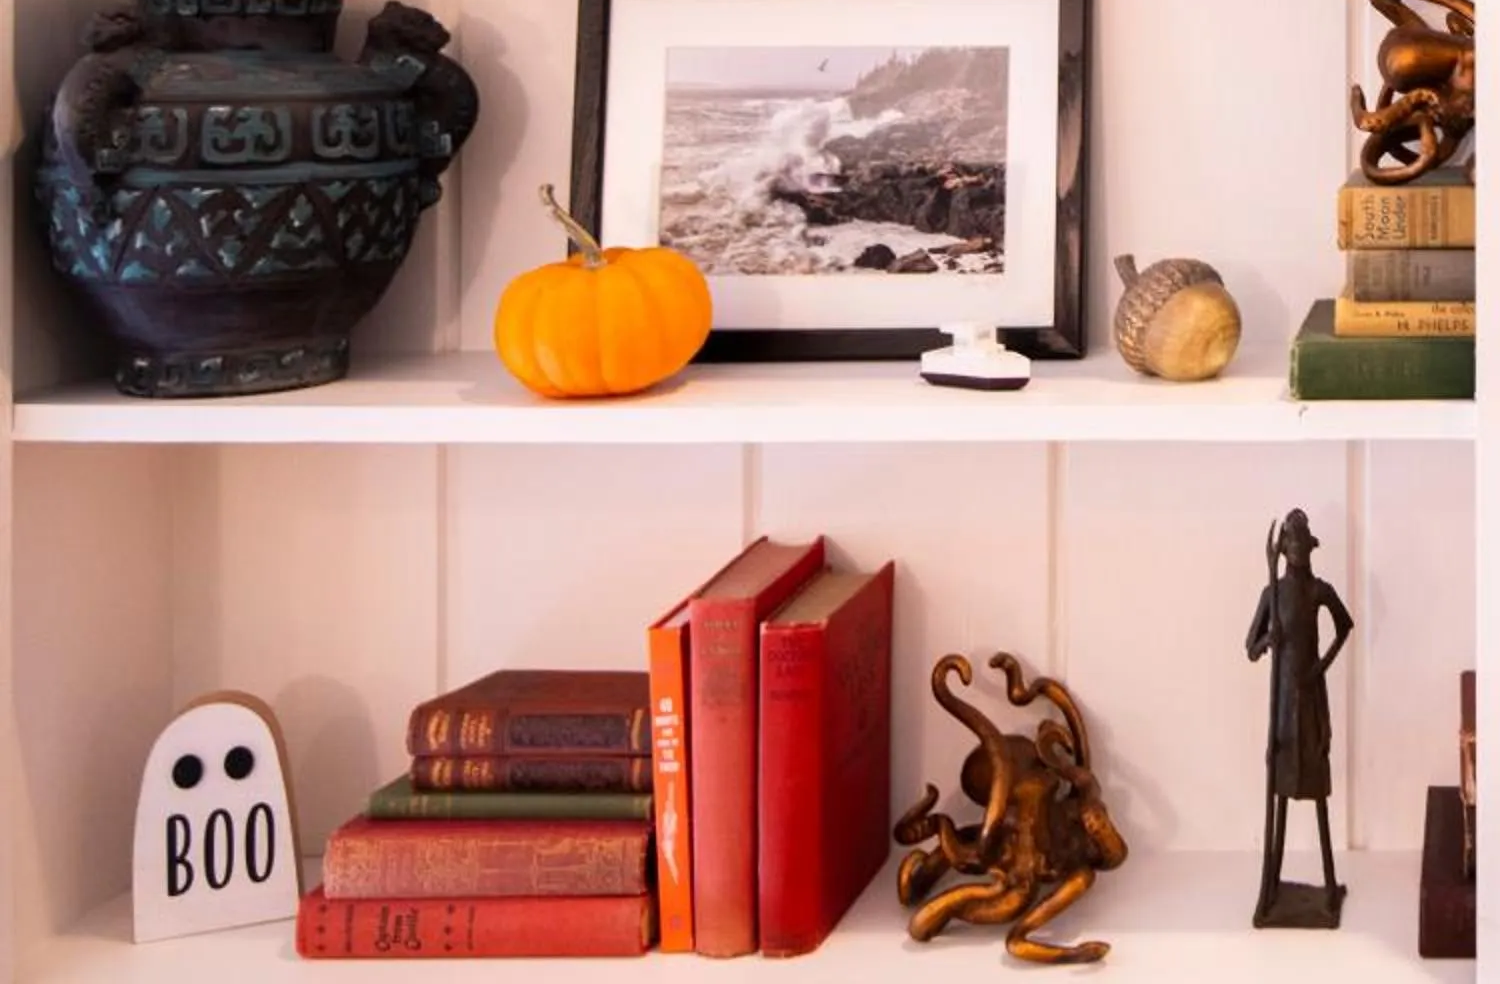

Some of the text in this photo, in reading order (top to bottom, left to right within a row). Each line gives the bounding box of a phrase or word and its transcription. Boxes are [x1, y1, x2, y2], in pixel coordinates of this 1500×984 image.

[1355, 195, 1374, 242] South
[1377, 196, 1391, 241] Moon
[1393, 195, 1407, 241] Under
[167, 801, 275, 897] BOO
